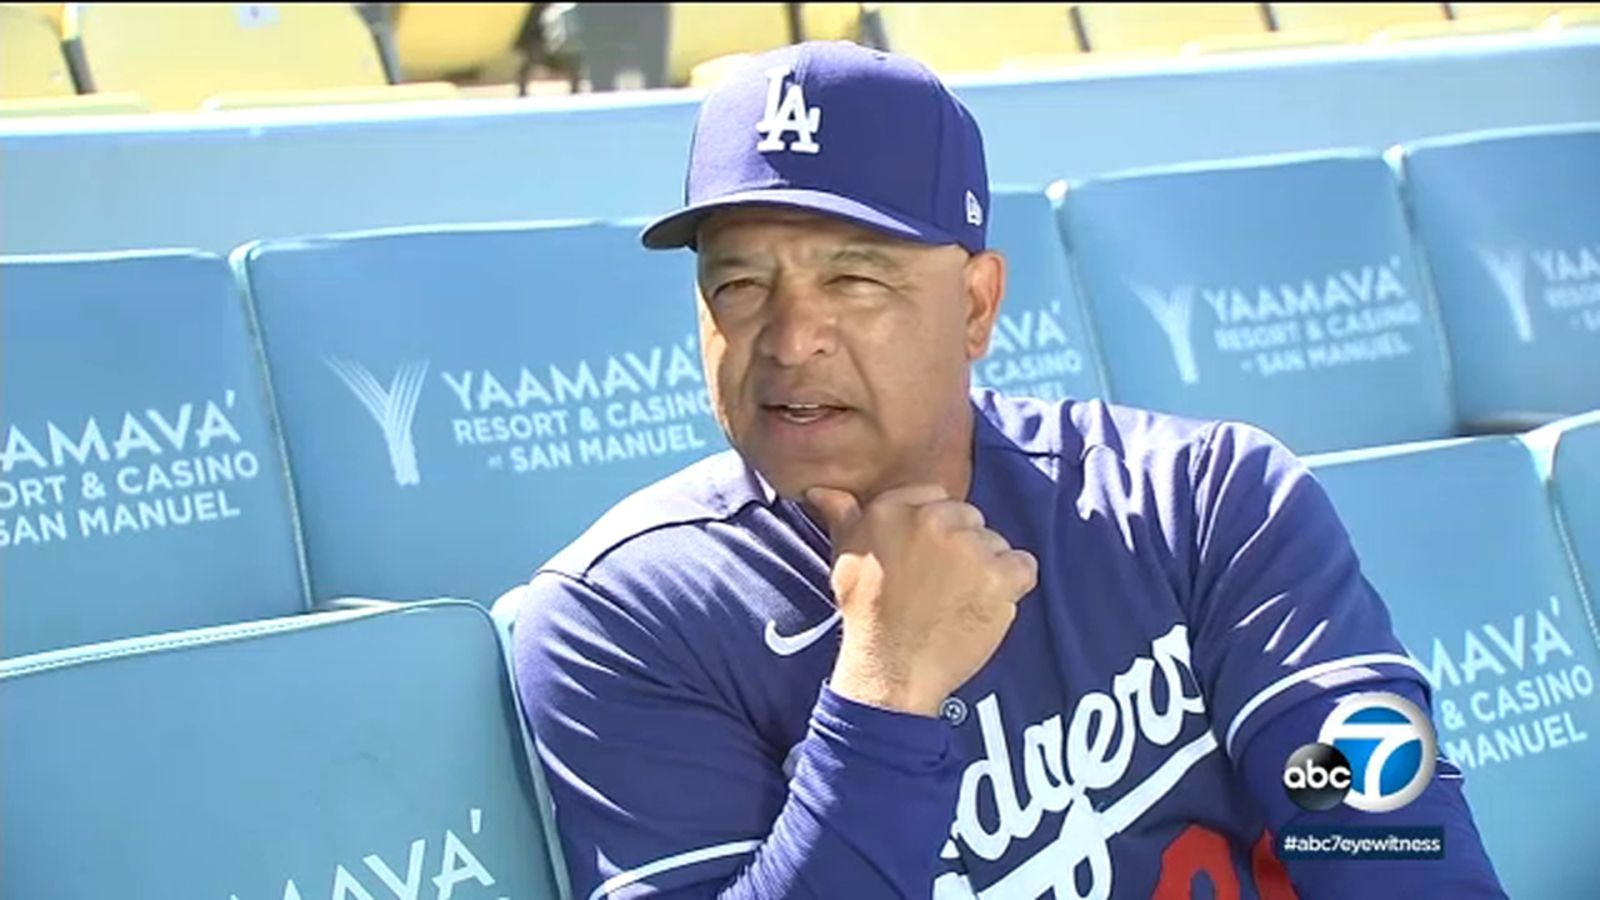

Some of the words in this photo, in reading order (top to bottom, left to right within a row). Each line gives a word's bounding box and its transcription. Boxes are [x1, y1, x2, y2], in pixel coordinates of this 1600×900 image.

[756, 66, 821, 153] LA
[1202, 255, 1405, 322] YAAMAVA'
[441, 333, 702, 412] YAAMAVA'
[453, 408, 569, 446] RESORT
[579, 405, 599, 433] &
[510, 440, 573, 473] SAN
[579, 423, 706, 464] MANUEL
[80, 470, 106, 501] &
[116, 450, 260, 495] CASINO
[78, 489, 242, 538] MANUEL
[1441, 699, 1466, 731] &
[1469, 665, 1595, 724] CASINO
[1444, 711, 1588, 769] MANUEL
